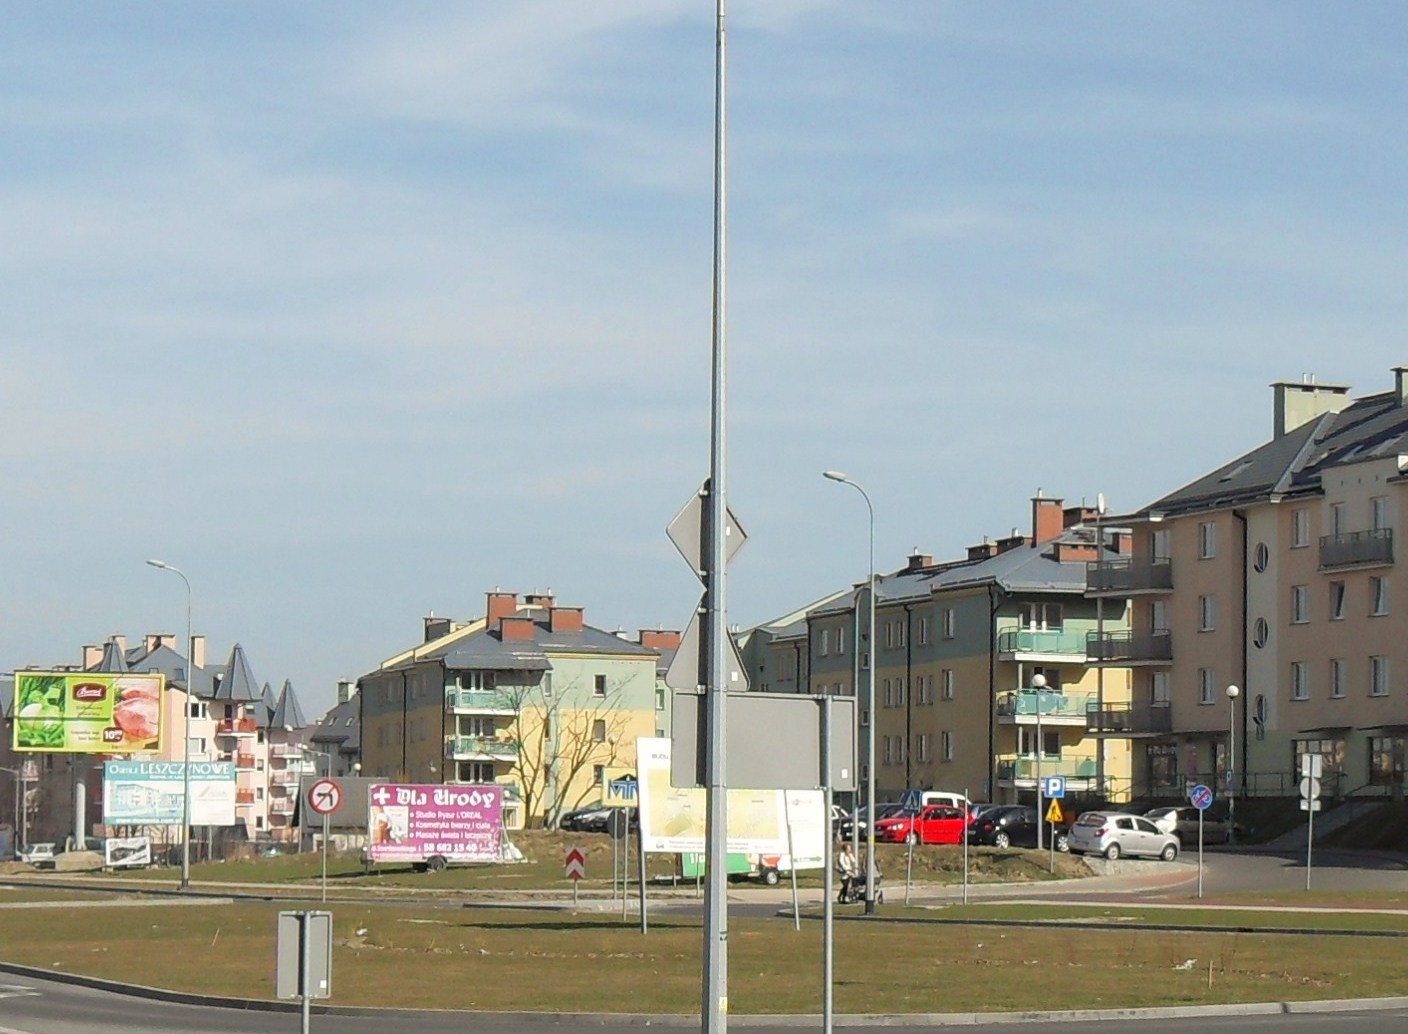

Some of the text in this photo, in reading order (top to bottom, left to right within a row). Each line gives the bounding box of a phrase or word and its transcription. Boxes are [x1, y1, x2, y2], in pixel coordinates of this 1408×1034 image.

[1049, 779, 1061, 795] P
[396, 788, 495, 808] Dla Urody
